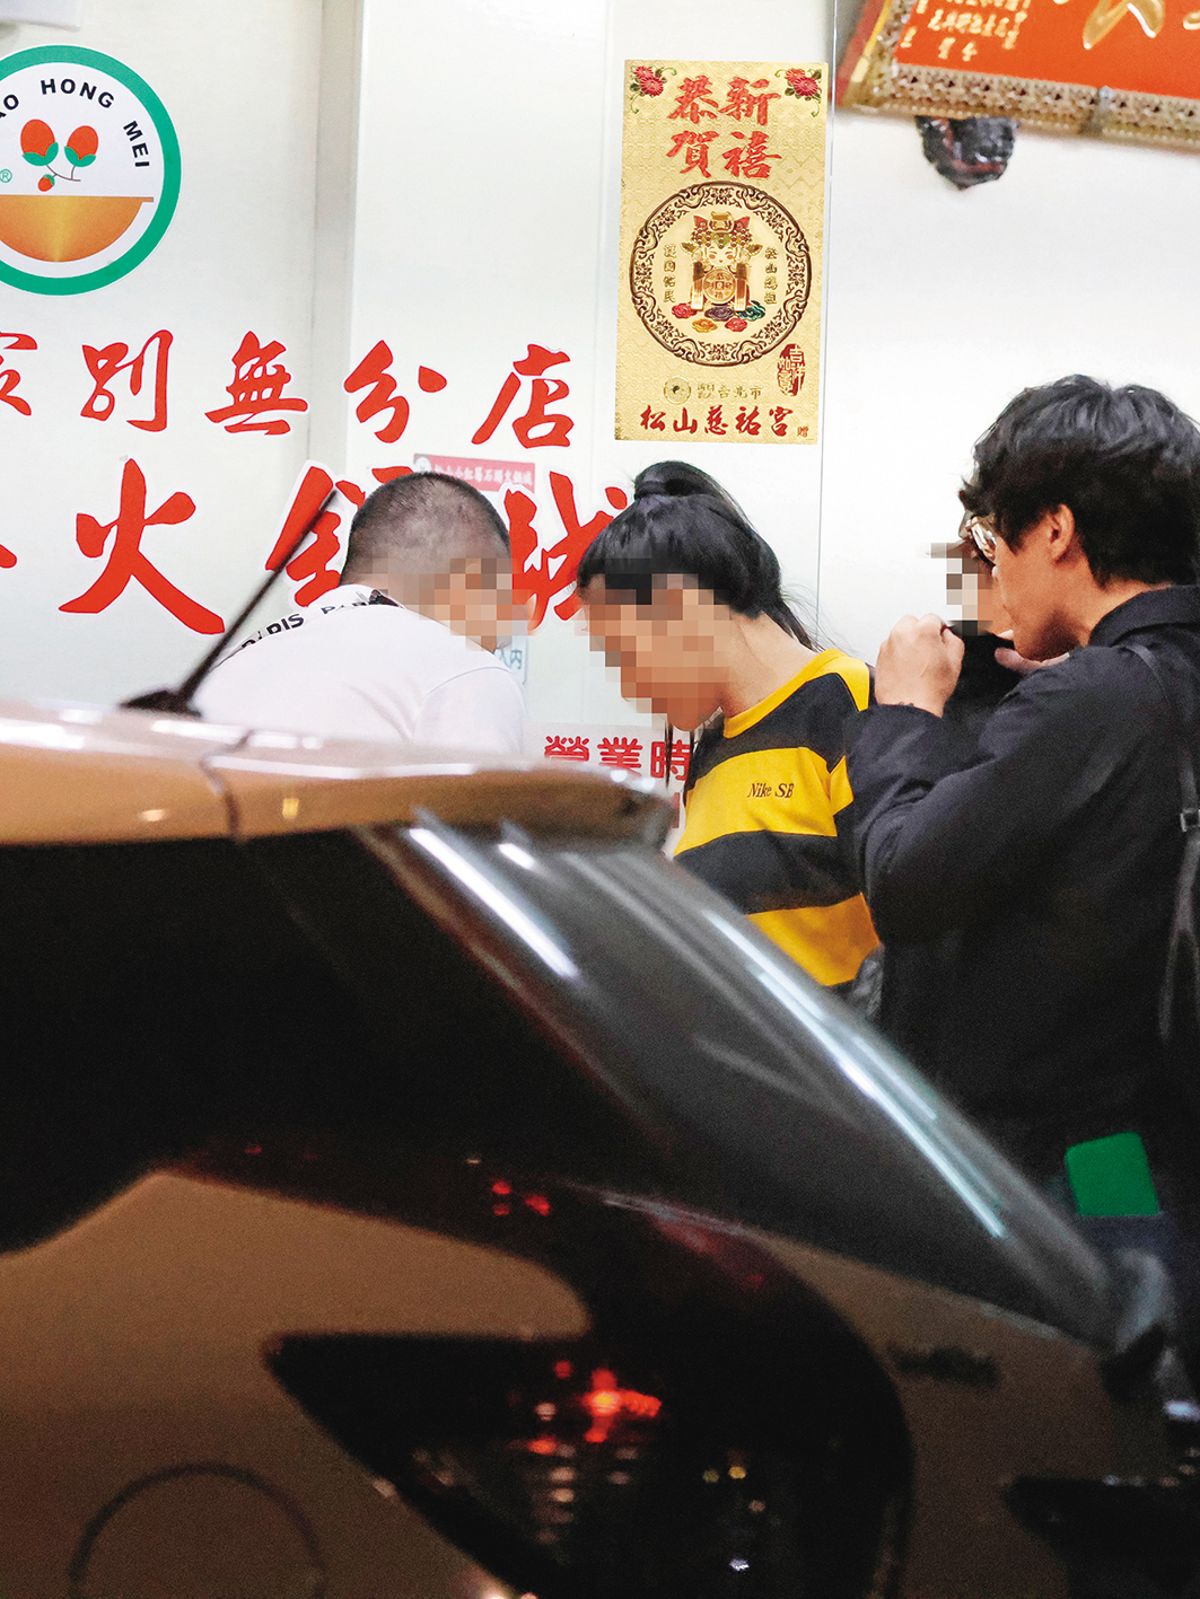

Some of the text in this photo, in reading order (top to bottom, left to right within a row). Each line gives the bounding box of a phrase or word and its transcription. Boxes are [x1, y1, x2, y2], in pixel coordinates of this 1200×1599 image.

[40, 78, 115, 109] HONG
[123, 120, 150, 168] MEI
[639, 404, 794, 437] 松山慈祐宮
[747, 782, 772, 798] Nike
